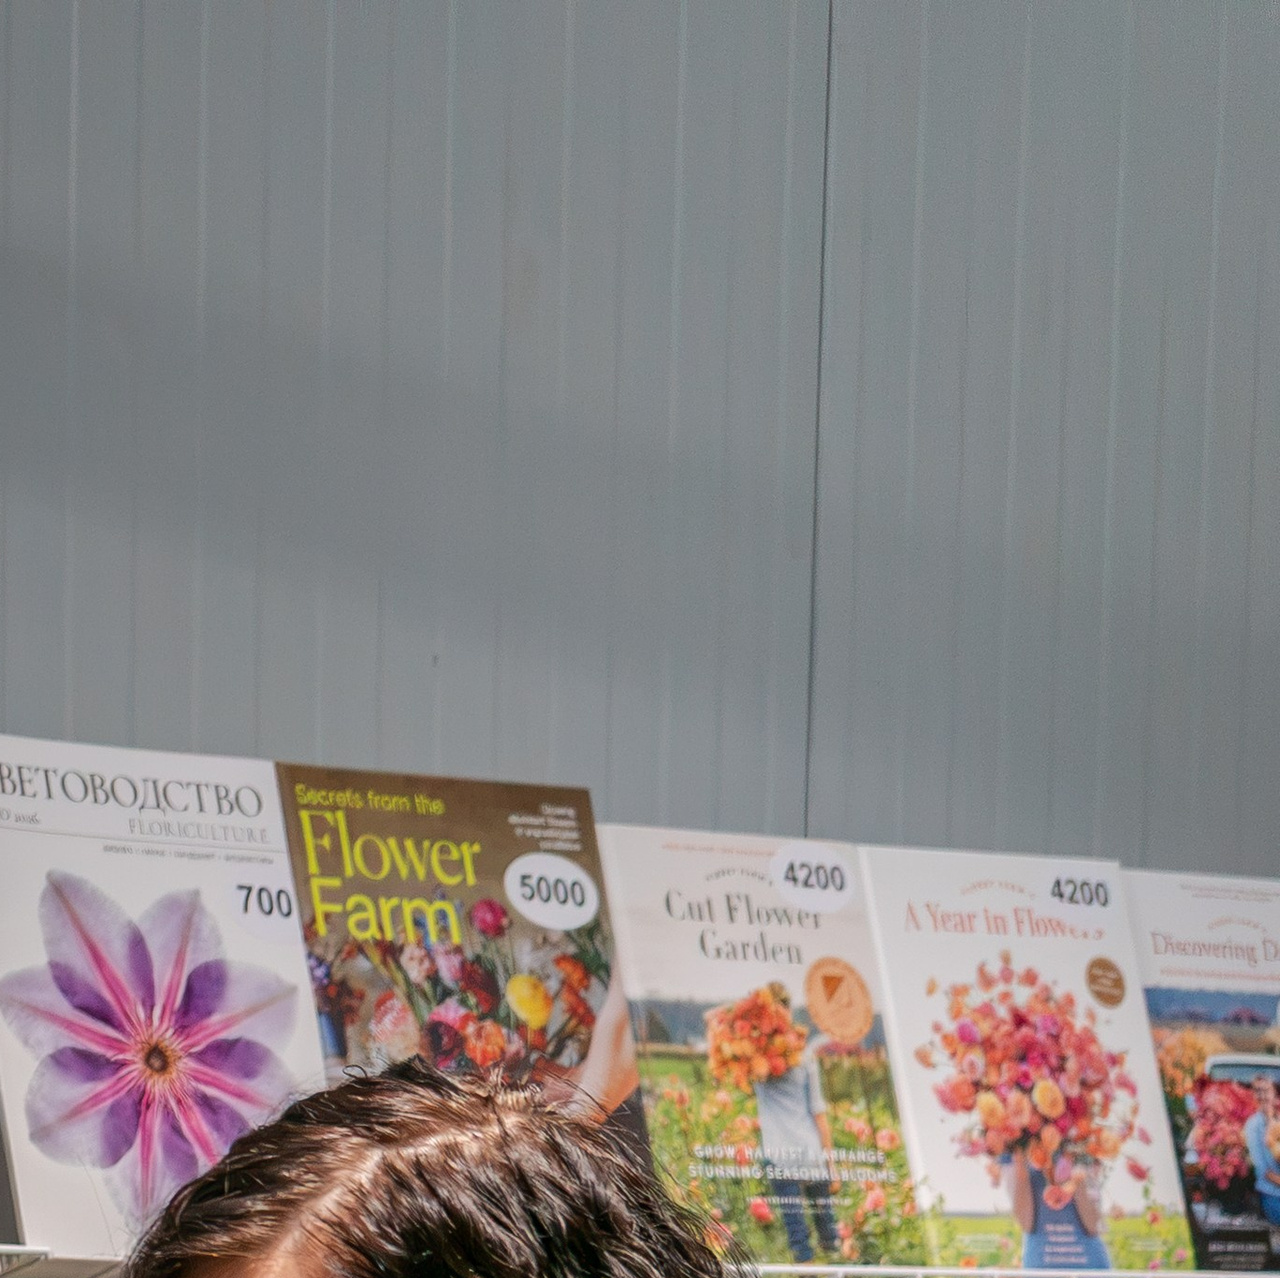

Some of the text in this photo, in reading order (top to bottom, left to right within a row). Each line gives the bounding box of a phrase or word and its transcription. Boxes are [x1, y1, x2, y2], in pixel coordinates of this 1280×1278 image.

[295, 783, 446, 816] Secrets from the
[128, 818, 270, 845] FLORICULTURE
[298, 809, 482, 887] Flower
[520, 874, 585, 908] 5000
[784, 862, 844, 892] 4200
[1051, 877, 1109, 908] 4200
[237, 885, 292, 918] 700
[309, 876, 462, 945] Farm
[664, 889, 822, 930] Cut Flower
[926, 902, 977, 935] Year
[700, 928, 803, 965] Garden
[1151, 930, 1258, 968] Discovering
